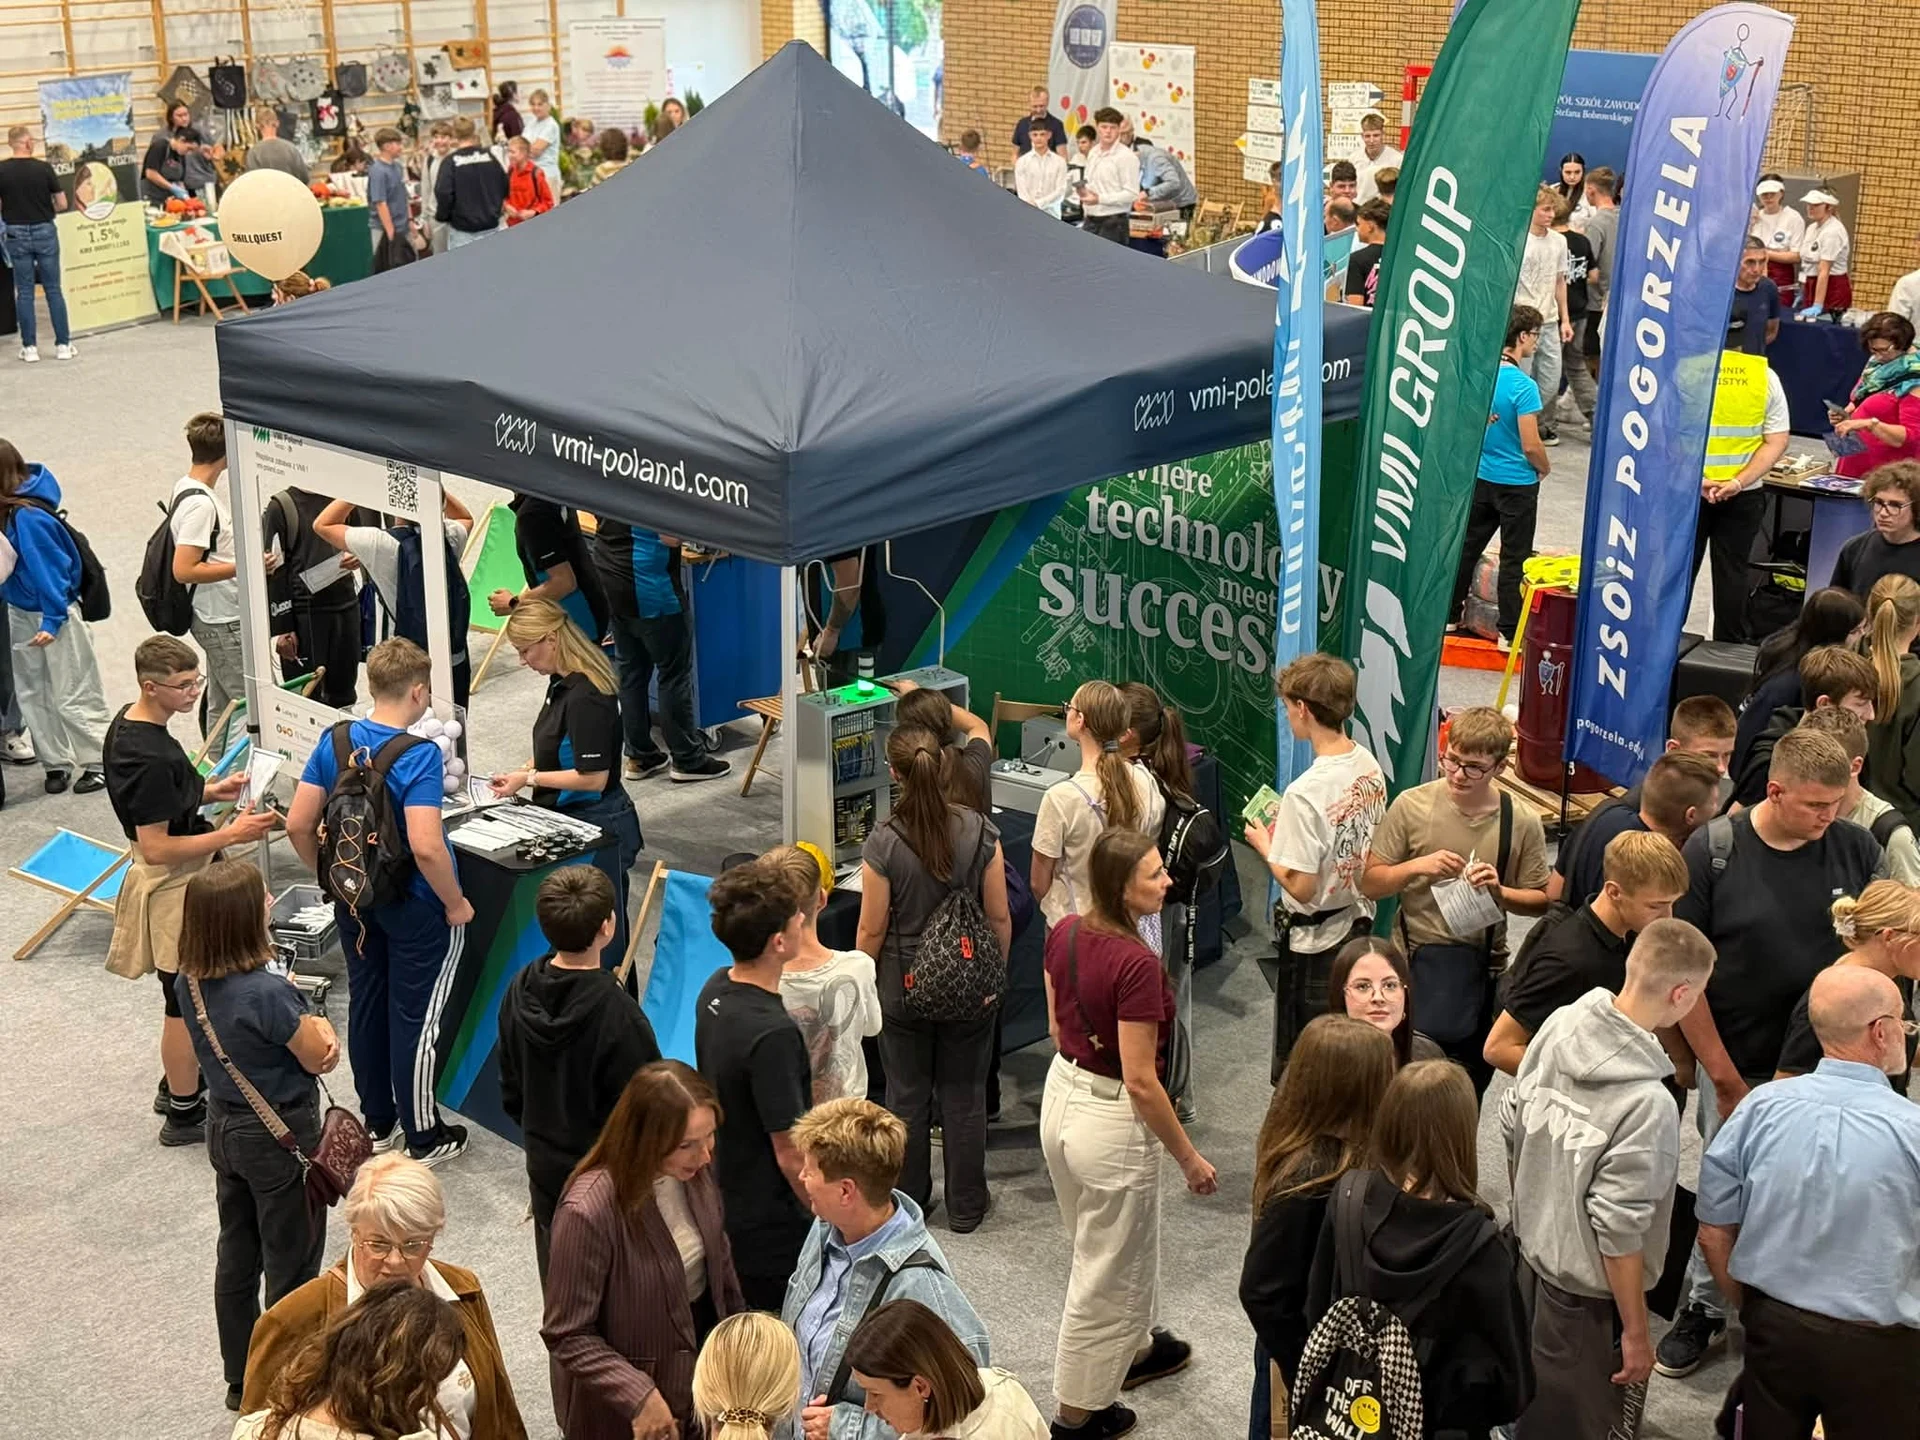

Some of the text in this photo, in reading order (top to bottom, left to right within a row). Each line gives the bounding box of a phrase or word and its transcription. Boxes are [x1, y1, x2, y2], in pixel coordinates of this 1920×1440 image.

[1556, 94, 1574, 106] PÓŁ
[1575, 95, 1602, 109] SZKÓŁ
[1582, 109, 1633, 126] Bobrowskiego
[89, 228, 120, 243] 1.5%
[232, 231, 282, 244] SKILLQUEST
[1389, 165, 1472, 428] GROUP
[1616, 116, 1708, 495] POGORZELA
[552, 432, 749, 508] vmi-poland.com
[1371, 433, 1421, 562] VMI
[1086, 486, 1345, 623] technoloy
[1038, 562, 1277, 679] succes
[1218, 577, 1278, 616] meet
[1598, 515, 1637, 700] ZSOiZ
[1325, 1386, 1351, 1415] THE
[1345, 1376, 1373, 1397] OFF
